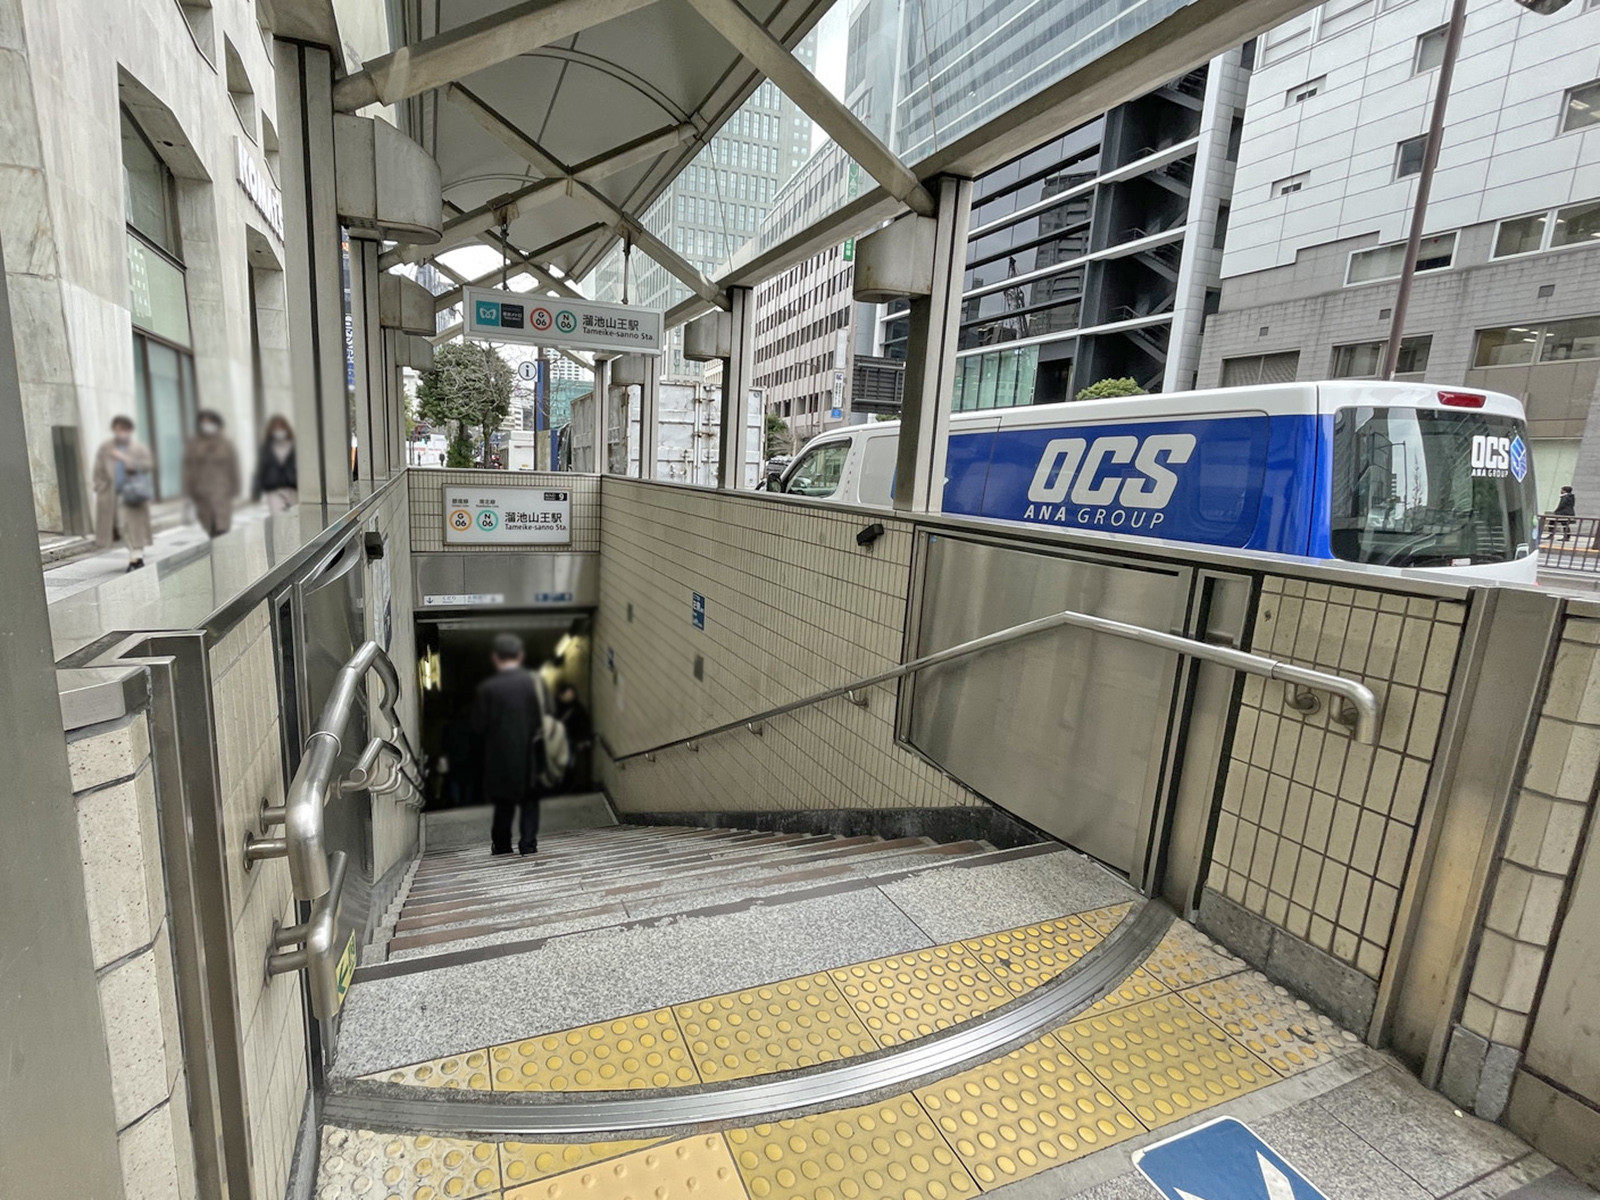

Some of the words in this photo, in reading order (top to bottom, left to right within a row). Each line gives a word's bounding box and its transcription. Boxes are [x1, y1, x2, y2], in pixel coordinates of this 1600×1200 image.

[538, 311, 545, 319] G
[536, 318, 547, 327] 06
[560, 320, 572, 329] 06
[582, 314, 639, 331] 溜池山王駅
[582, 327, 639, 340] Tameike-sanno
[641, 332, 655, 341] Sta.
[1471, 435, 1510, 469] OCS
[1028, 433, 1197, 509] OCS
[1471, 468, 1486, 477] ANA
[1487, 469, 1509, 478] GROUP
[558, 493, 564, 501] 9
[504, 511, 563, 523] 溜池山王駅
[1023, 504, 1066, 522] ANA
[1077, 507, 1165, 529] GROUP
[455, 519, 467, 527] 06
[505, 523, 554, 531] Tameike-sanno
